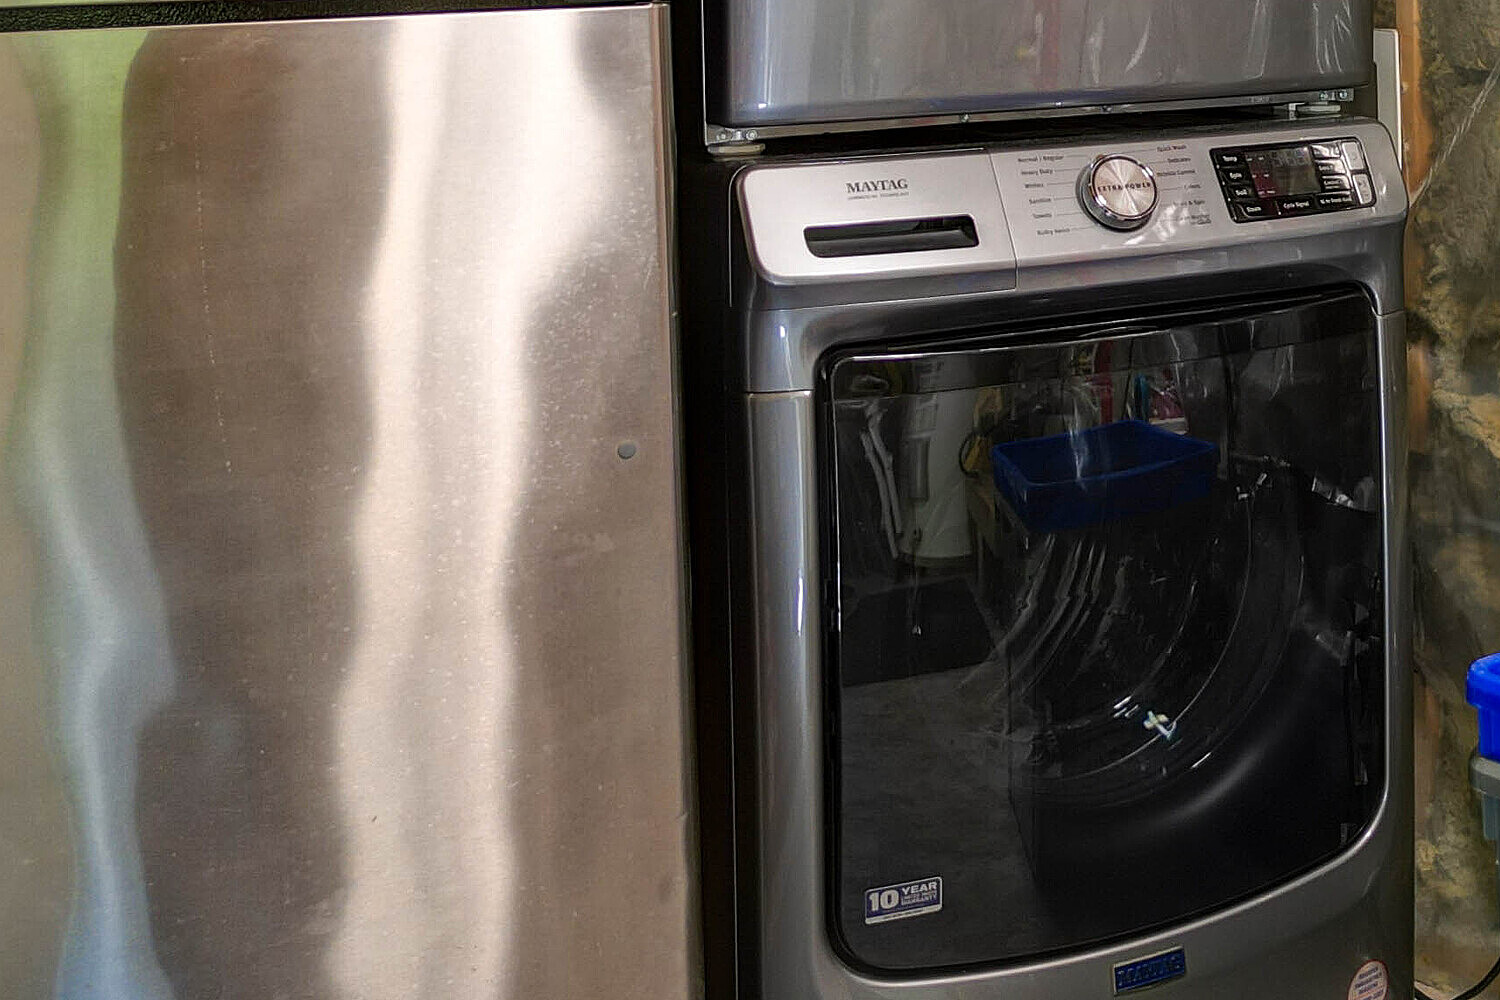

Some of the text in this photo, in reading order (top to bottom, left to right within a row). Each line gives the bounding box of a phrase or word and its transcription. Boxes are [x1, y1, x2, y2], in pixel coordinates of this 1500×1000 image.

[845, 178, 909, 193] MAYTAG
[902, 882, 937, 895] YEAR
[869, 890, 899, 911] 10
